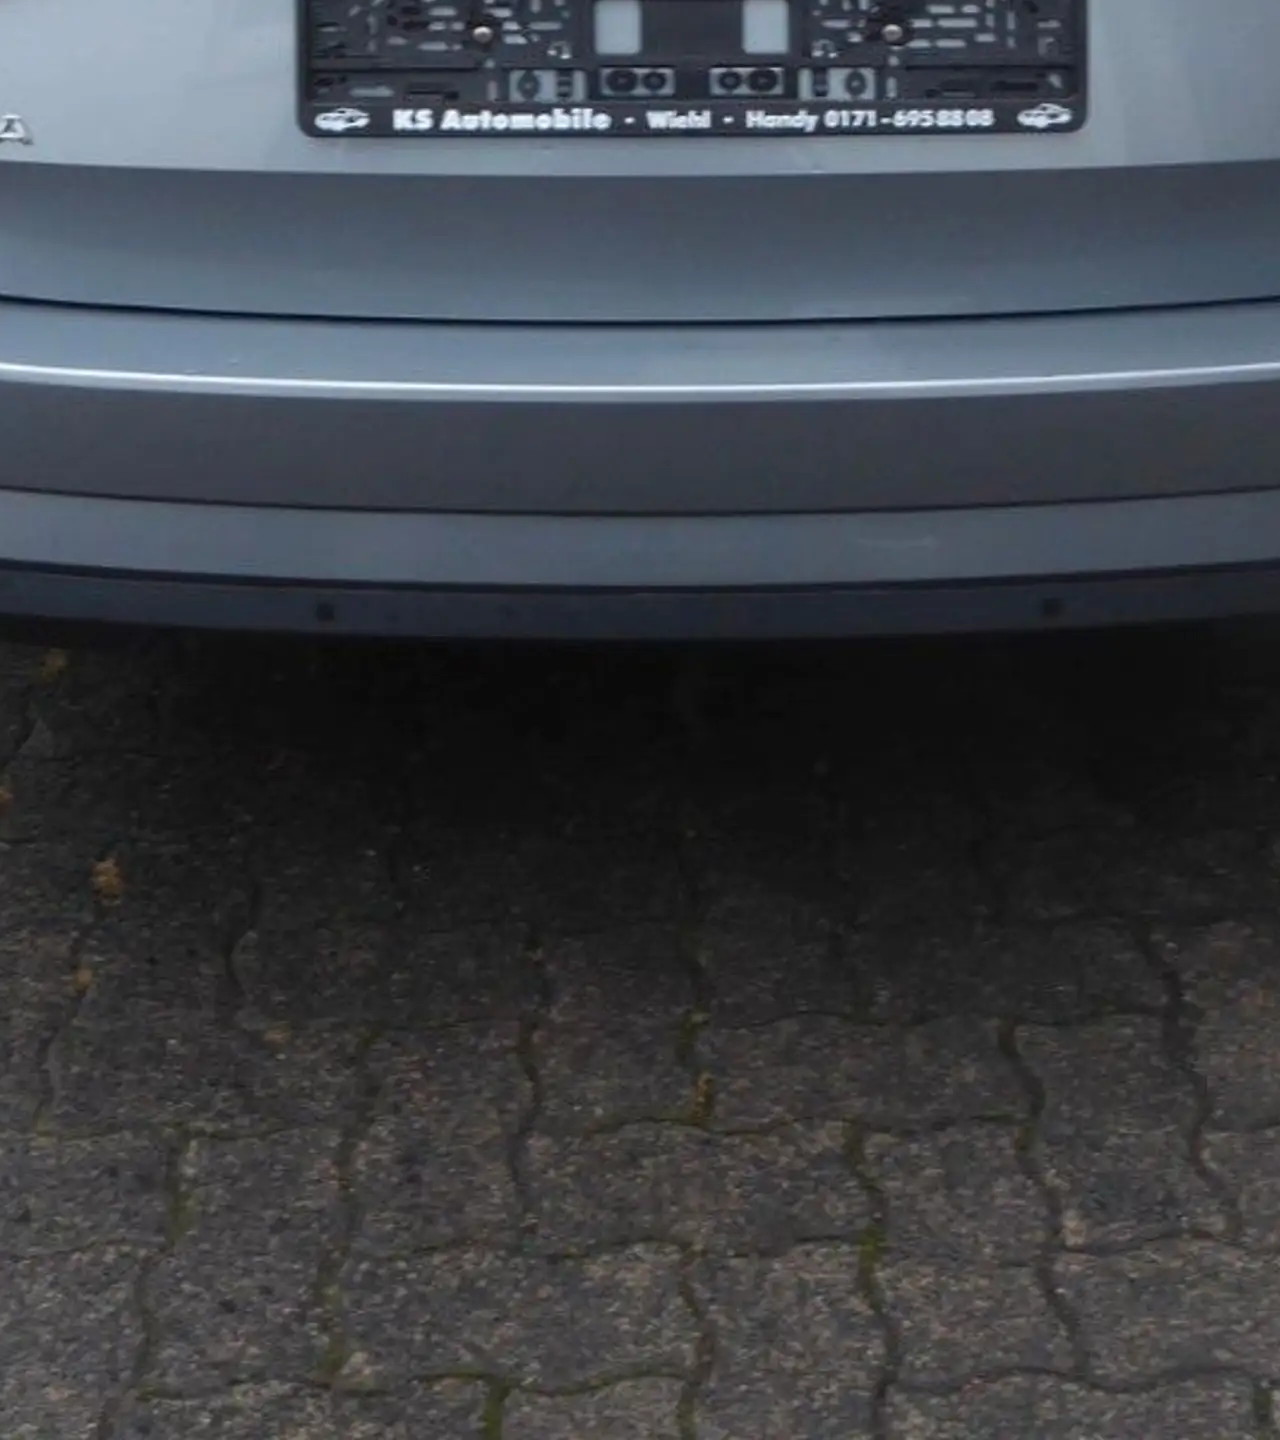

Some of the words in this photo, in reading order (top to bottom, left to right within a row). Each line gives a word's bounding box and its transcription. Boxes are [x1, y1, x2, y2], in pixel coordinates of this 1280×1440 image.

[391, 108, 434, 131] KS
[440, 108, 612, 131] Automobile
[646, 110, 712, 130] Wiehl
[745, 109, 818, 132] Handy
